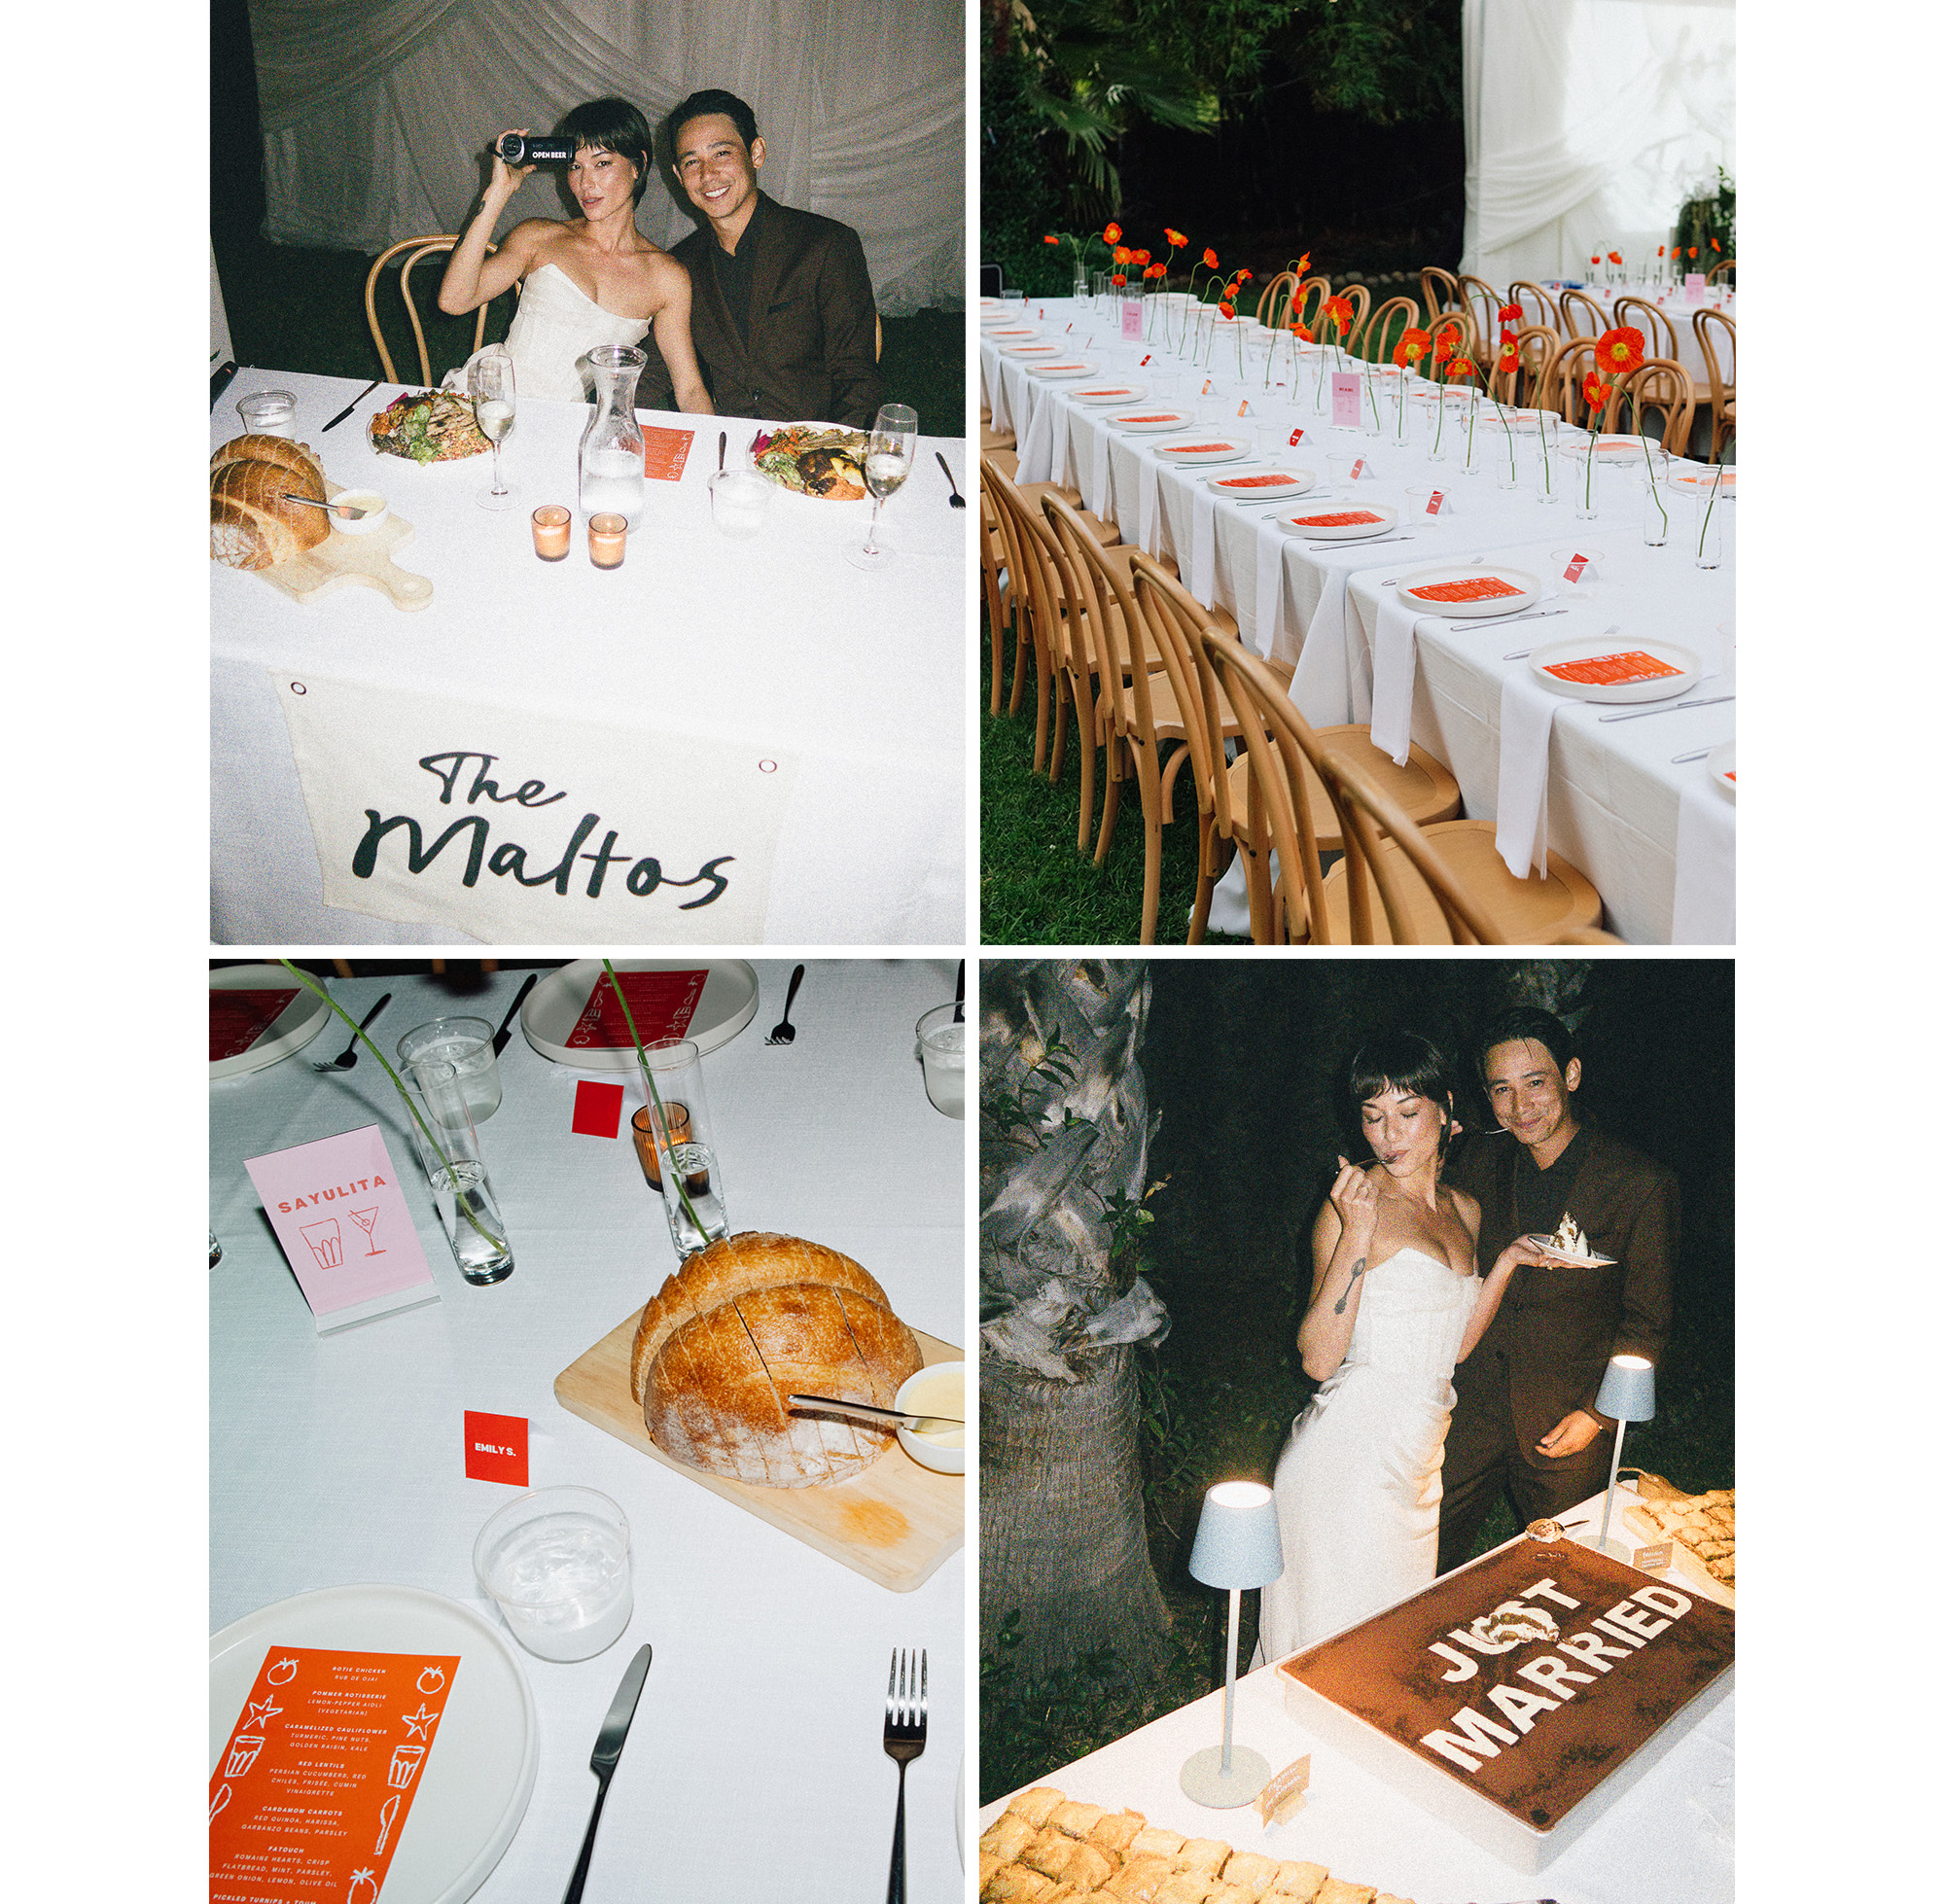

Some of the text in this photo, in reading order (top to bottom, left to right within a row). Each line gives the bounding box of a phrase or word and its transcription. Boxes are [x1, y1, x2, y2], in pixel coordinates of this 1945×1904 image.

[418, 751, 567, 808] The
[352, 808, 736, 910] Maltos
[277, 1175, 387, 1214] SAYULITA
[475, 1442, 516, 1457] EMILY S.
[1419, 1585, 1693, 1774] MARRIED
[284, 1723, 388, 1735] CARAMELIZED CAULIFLOWER
[286, 1788, 335, 1797] VINAIGRETTE
[262, 1806, 343, 1817] CARDAMOM CARROTS
[241, 1824, 282, 1833] GARBANZO
[267, 1846, 304, 1854] FATOUCH
[233, 1853, 269, 1862] ROMAINE
[212, 1894, 247, 1903] PICKLED
